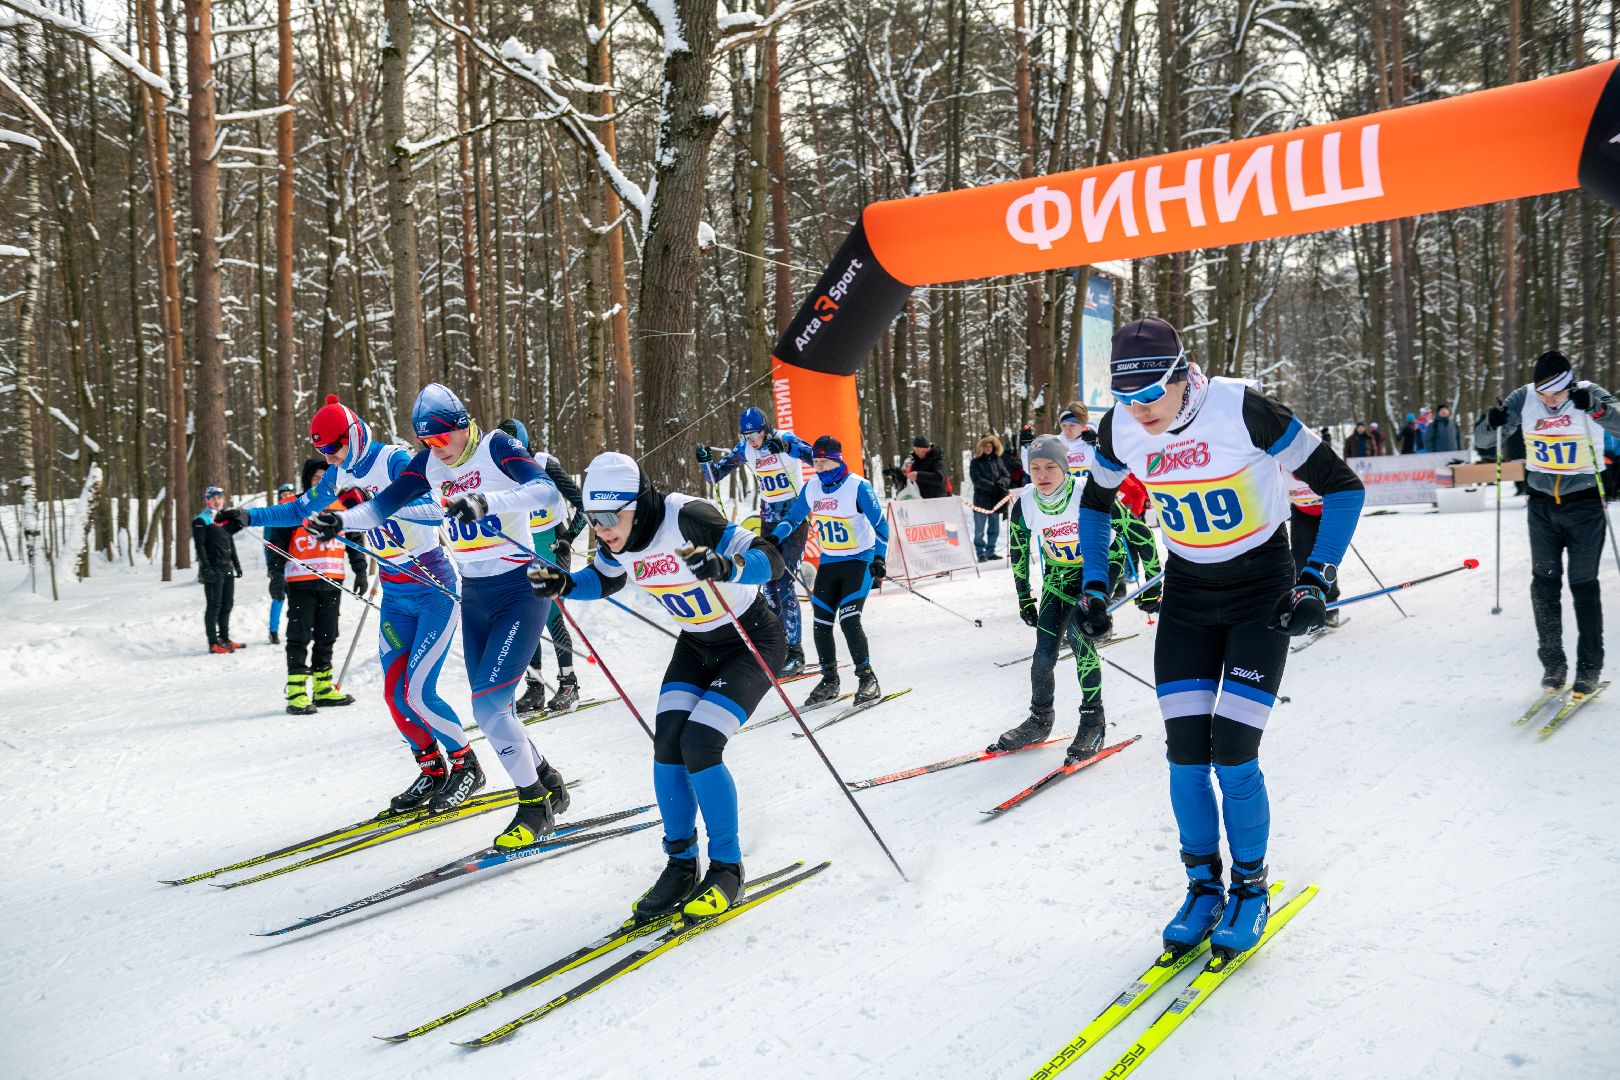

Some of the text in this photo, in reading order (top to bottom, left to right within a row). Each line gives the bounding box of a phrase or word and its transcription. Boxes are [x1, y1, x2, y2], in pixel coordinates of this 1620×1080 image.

[1006, 124, 1384, 250] ФИНИШ
[795, 258, 863, 351] Arta Sport
[772, 378, 793, 432] СКИЙ
[1146, 441, 1211, 478] Джаз
[1166, 439, 1195, 449] орешки
[1533, 440, 1577, 464] 317
[1152, 488, 1244, 533] 319
[366, 518, 406, 550] 09
[633, 555, 680, 581] Джаз
[410, 637, 430, 669] CRAFT
[489, 667, 500, 683] РУС
[447, 772, 475, 807] ROSSI
[505, 848, 540, 862] salomon
[626, 916, 673, 943] FISCHER
[678, 918, 719, 945] FISCHER
[1030, 1036, 1087, 1080] FISCHE
